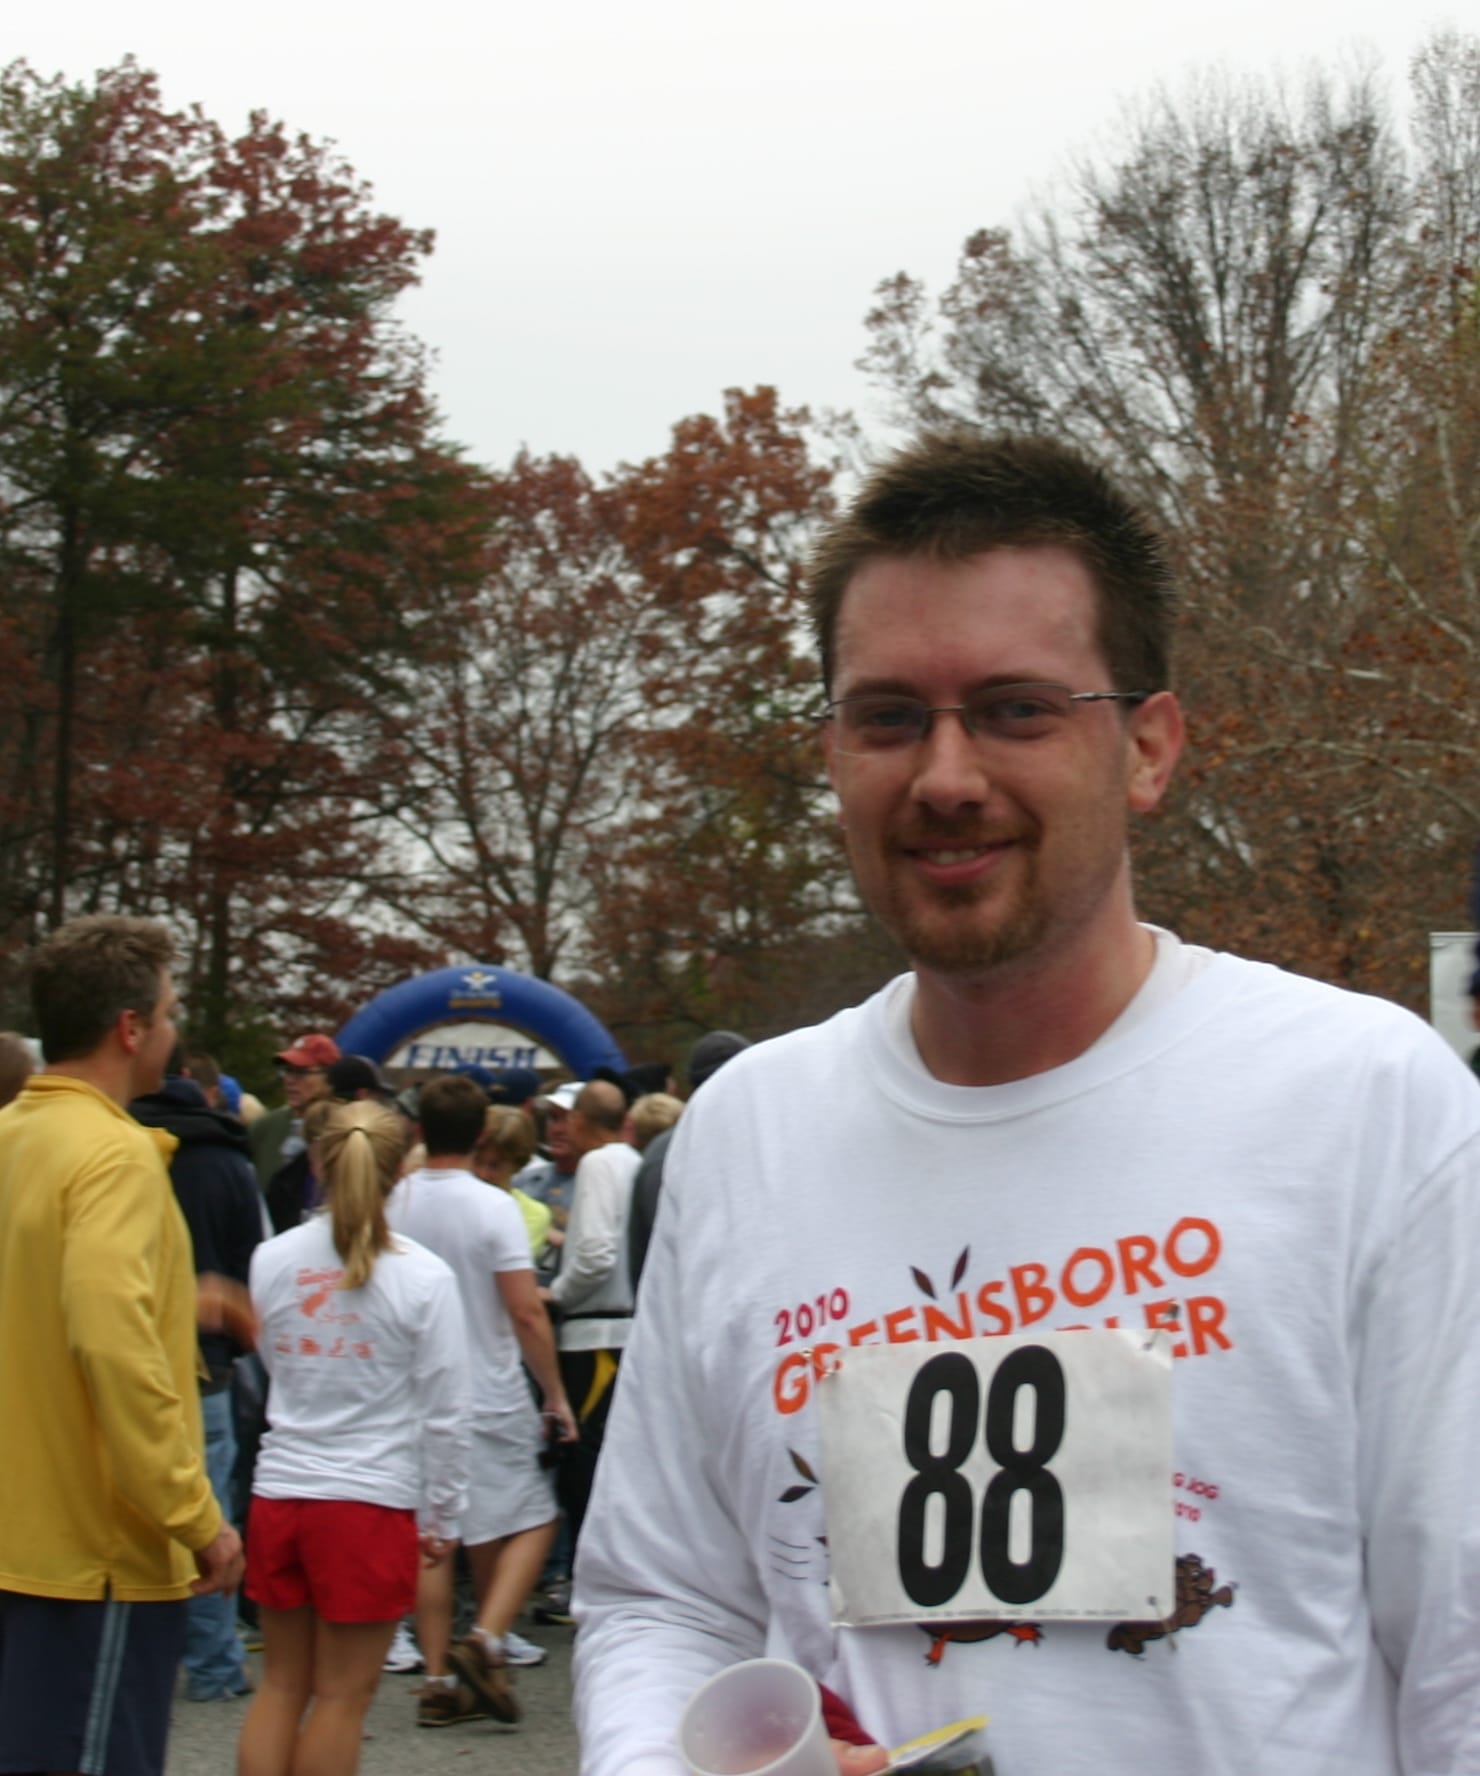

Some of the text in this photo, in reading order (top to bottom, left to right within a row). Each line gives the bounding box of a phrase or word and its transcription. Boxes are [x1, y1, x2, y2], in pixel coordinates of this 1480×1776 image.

[405, 1044, 537, 1068] FINISH
[775, 1288, 850, 1347] 2010
[898, 1345, 1065, 1606] 88
